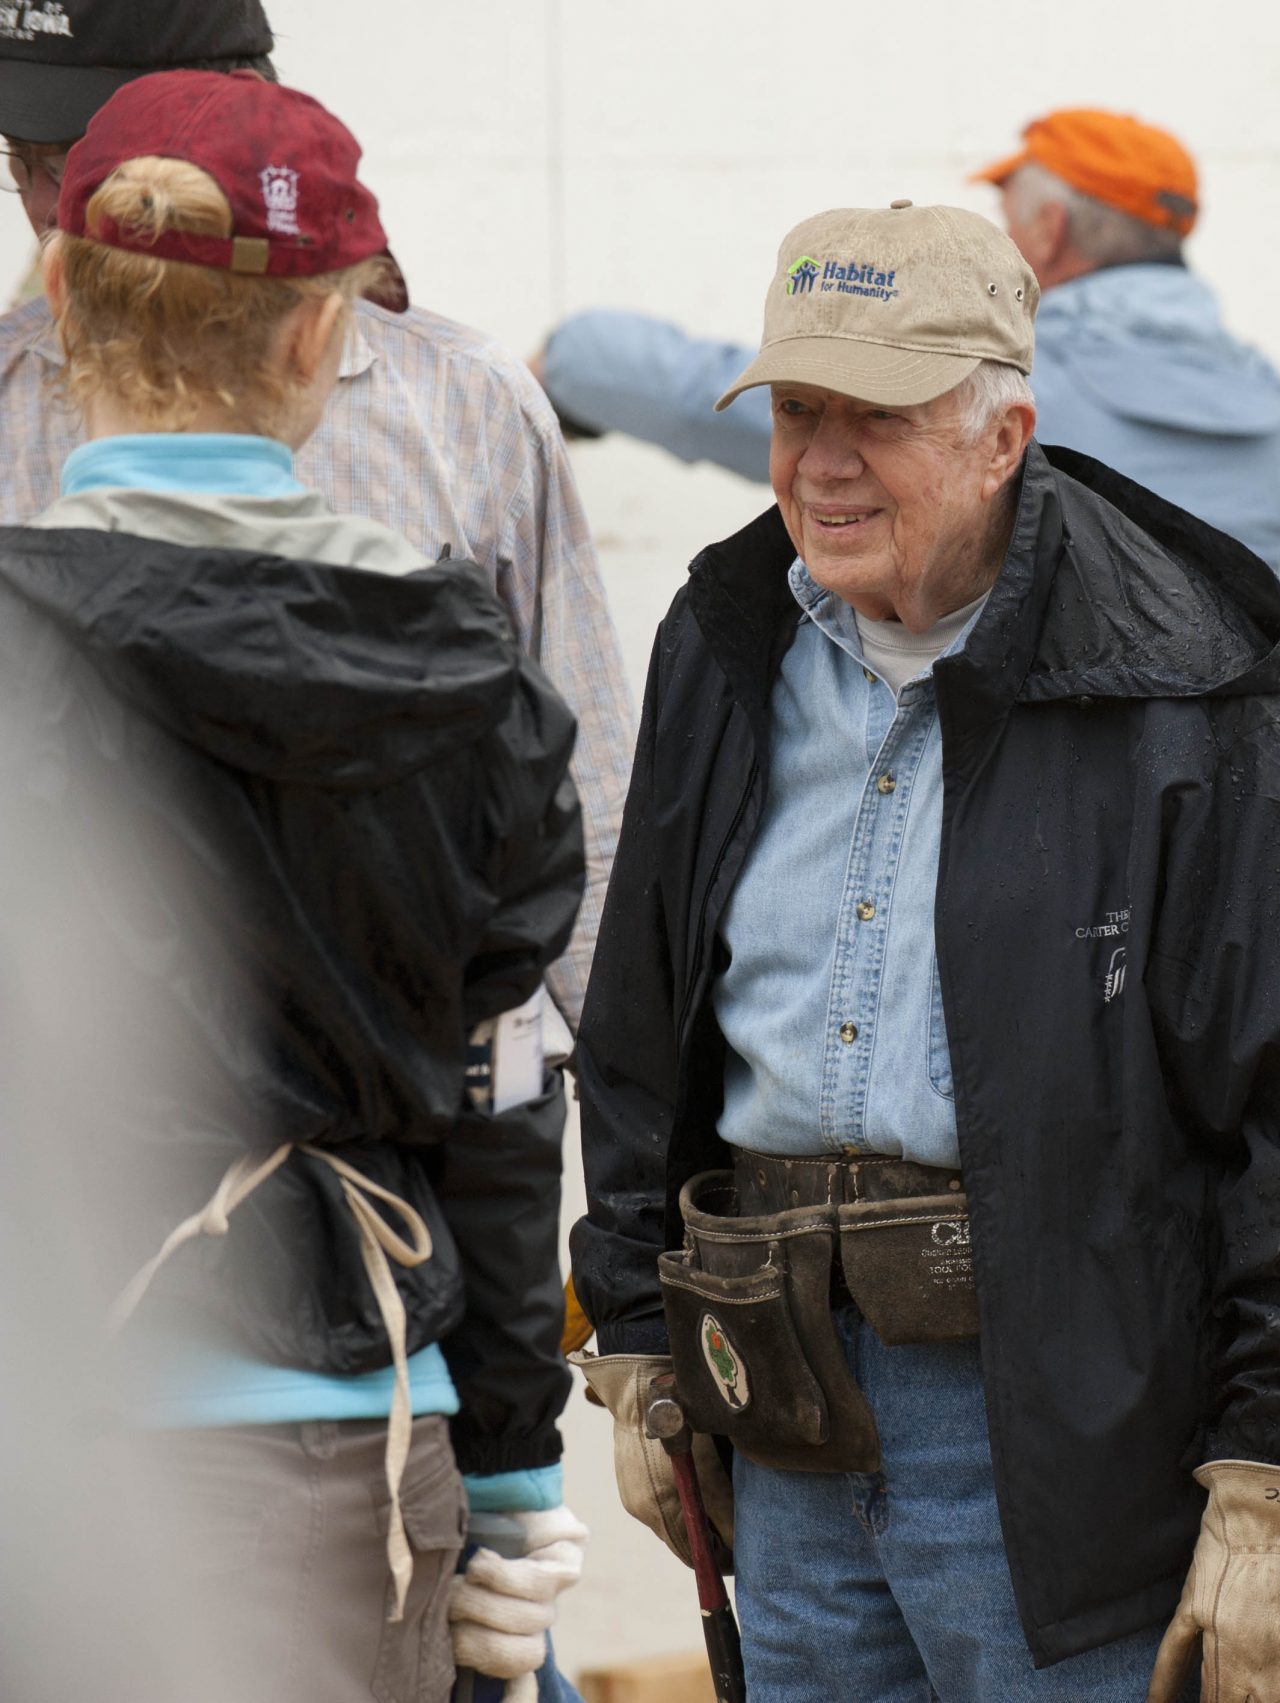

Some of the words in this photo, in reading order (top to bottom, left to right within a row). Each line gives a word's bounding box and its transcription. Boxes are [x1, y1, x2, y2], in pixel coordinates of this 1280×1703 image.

[823, 261, 896, 288] Habitat
[820, 281, 835, 292] for
[837, 281, 894, 302] Humanity
[1106, 910, 1131, 923] THE
[1075, 924, 1120, 938] CARTER
